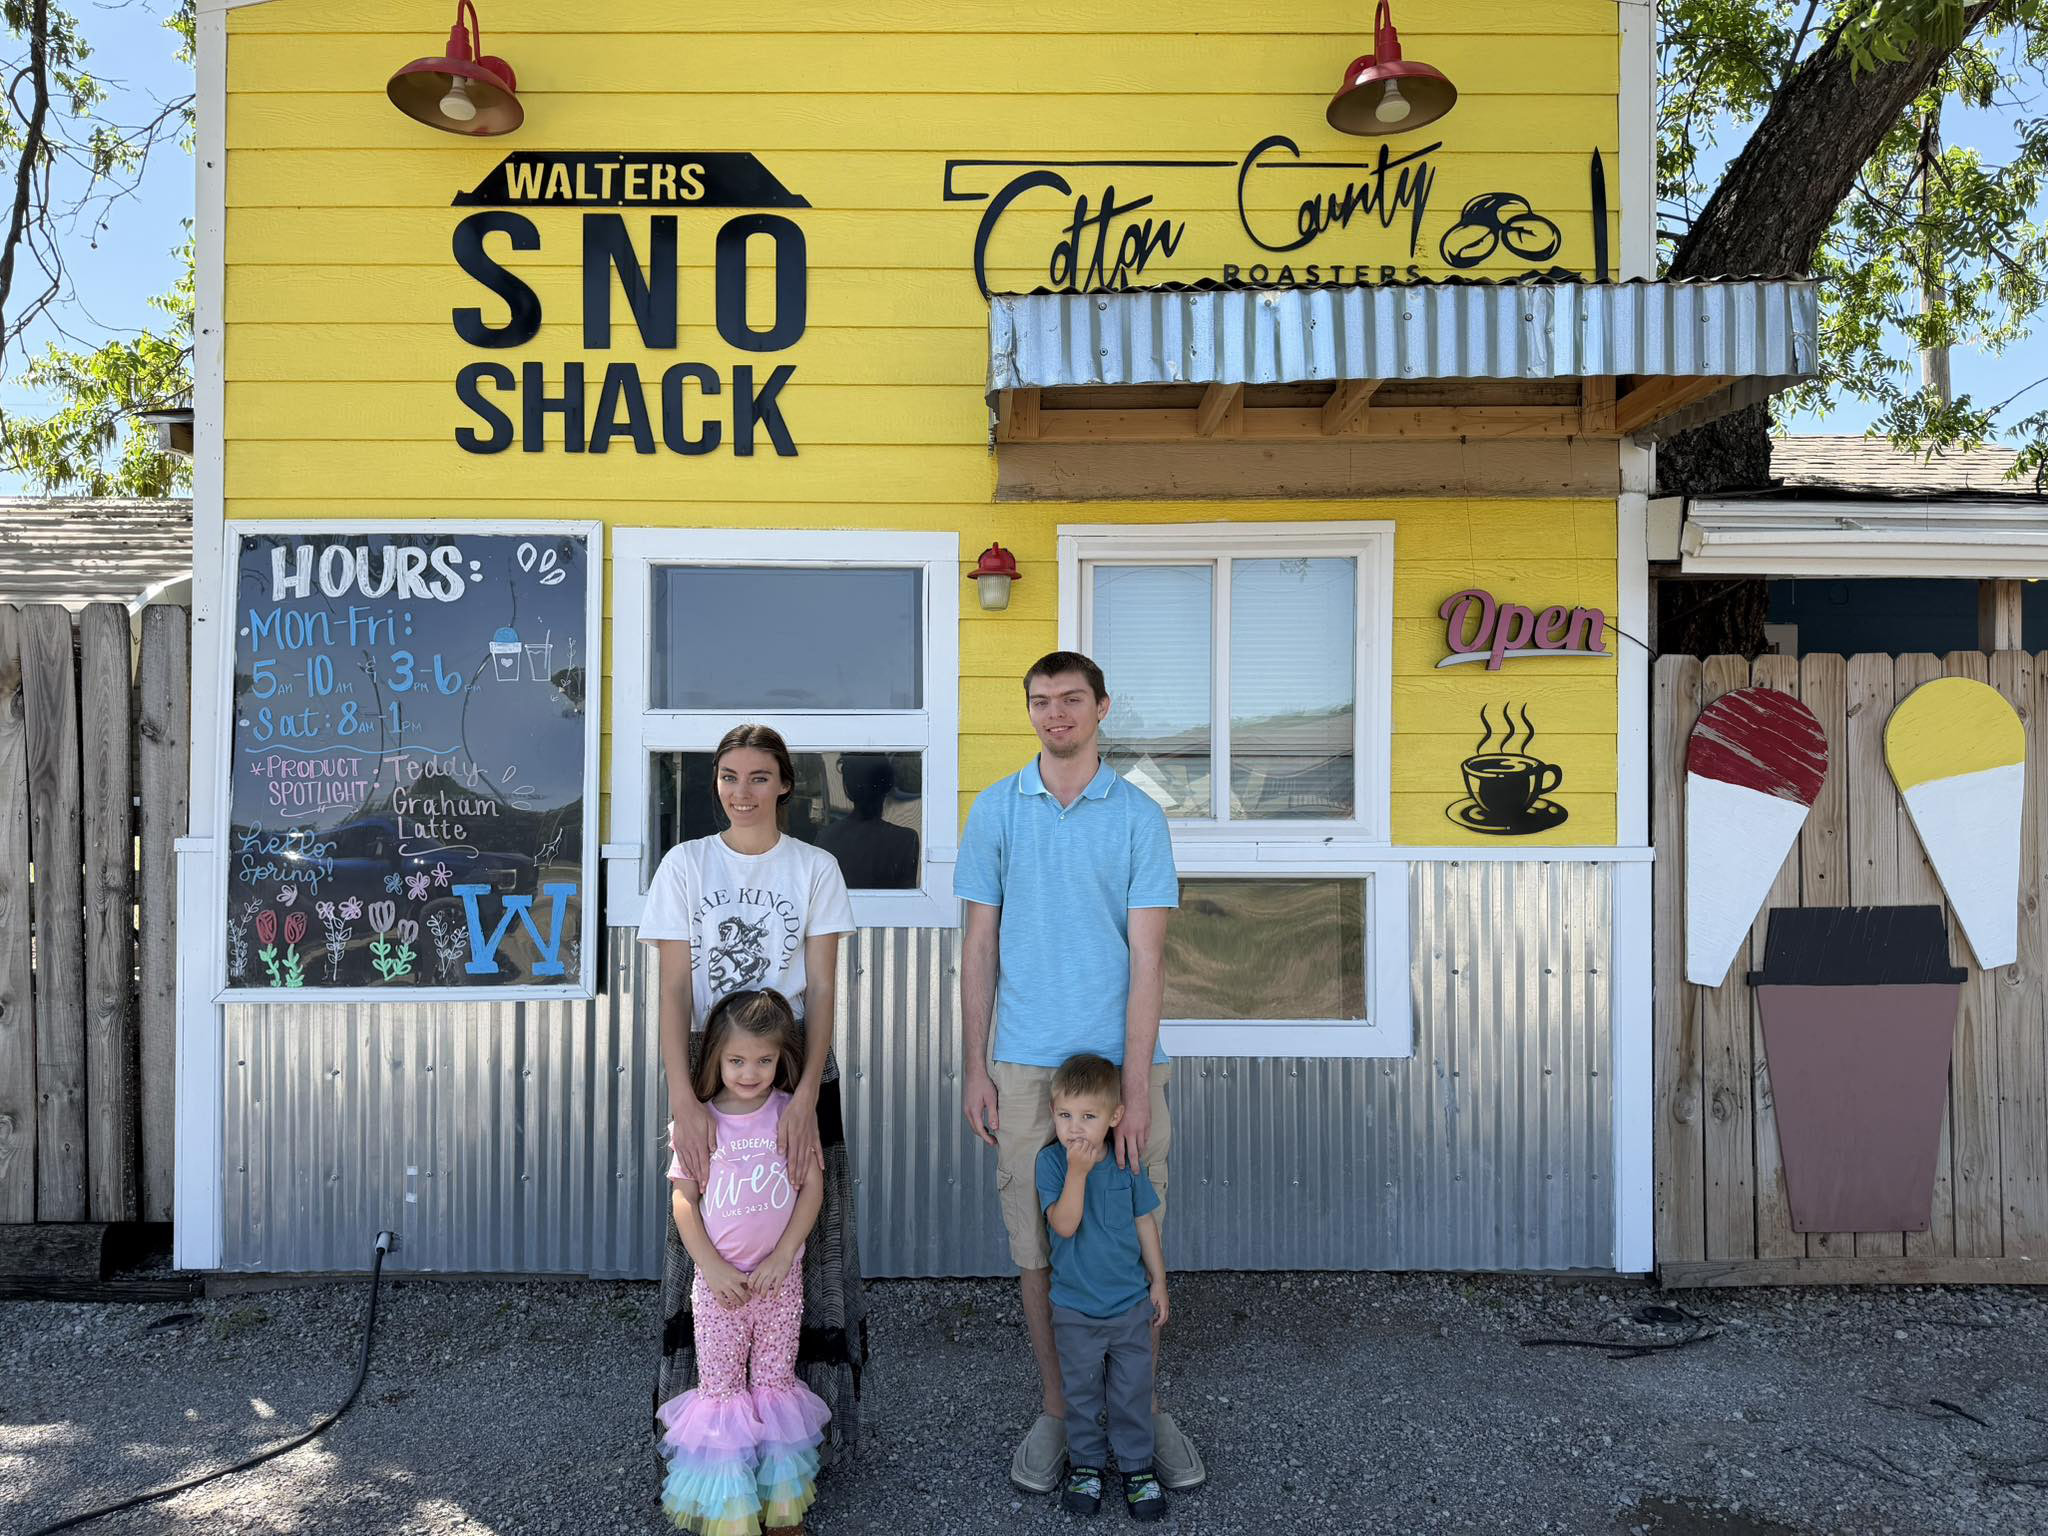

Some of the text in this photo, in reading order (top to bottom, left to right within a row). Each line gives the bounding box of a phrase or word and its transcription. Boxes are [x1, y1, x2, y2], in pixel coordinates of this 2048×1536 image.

[505, 162, 706, 200] WALTERS
[452, 210, 807, 353] SNO
[1223, 263, 1420, 285] ROASTERS
[454, 361, 799, 457] SHACK
[271, 544, 484, 602] HOURS:
[1437, 588, 1606, 671] Open
[253, 706, 331, 741] Sat:
[383, 754, 488, 787] Teddy
[392, 786, 500, 819] Graham
[238, 820, 337, 857] hello
[397, 816, 467, 840] Latte
[451, 883, 577, 977] W
[692, 889, 731, 926] THE
[738, 887, 800, 972] KINGDOM
[721, 1207, 743, 1218] LUKE
